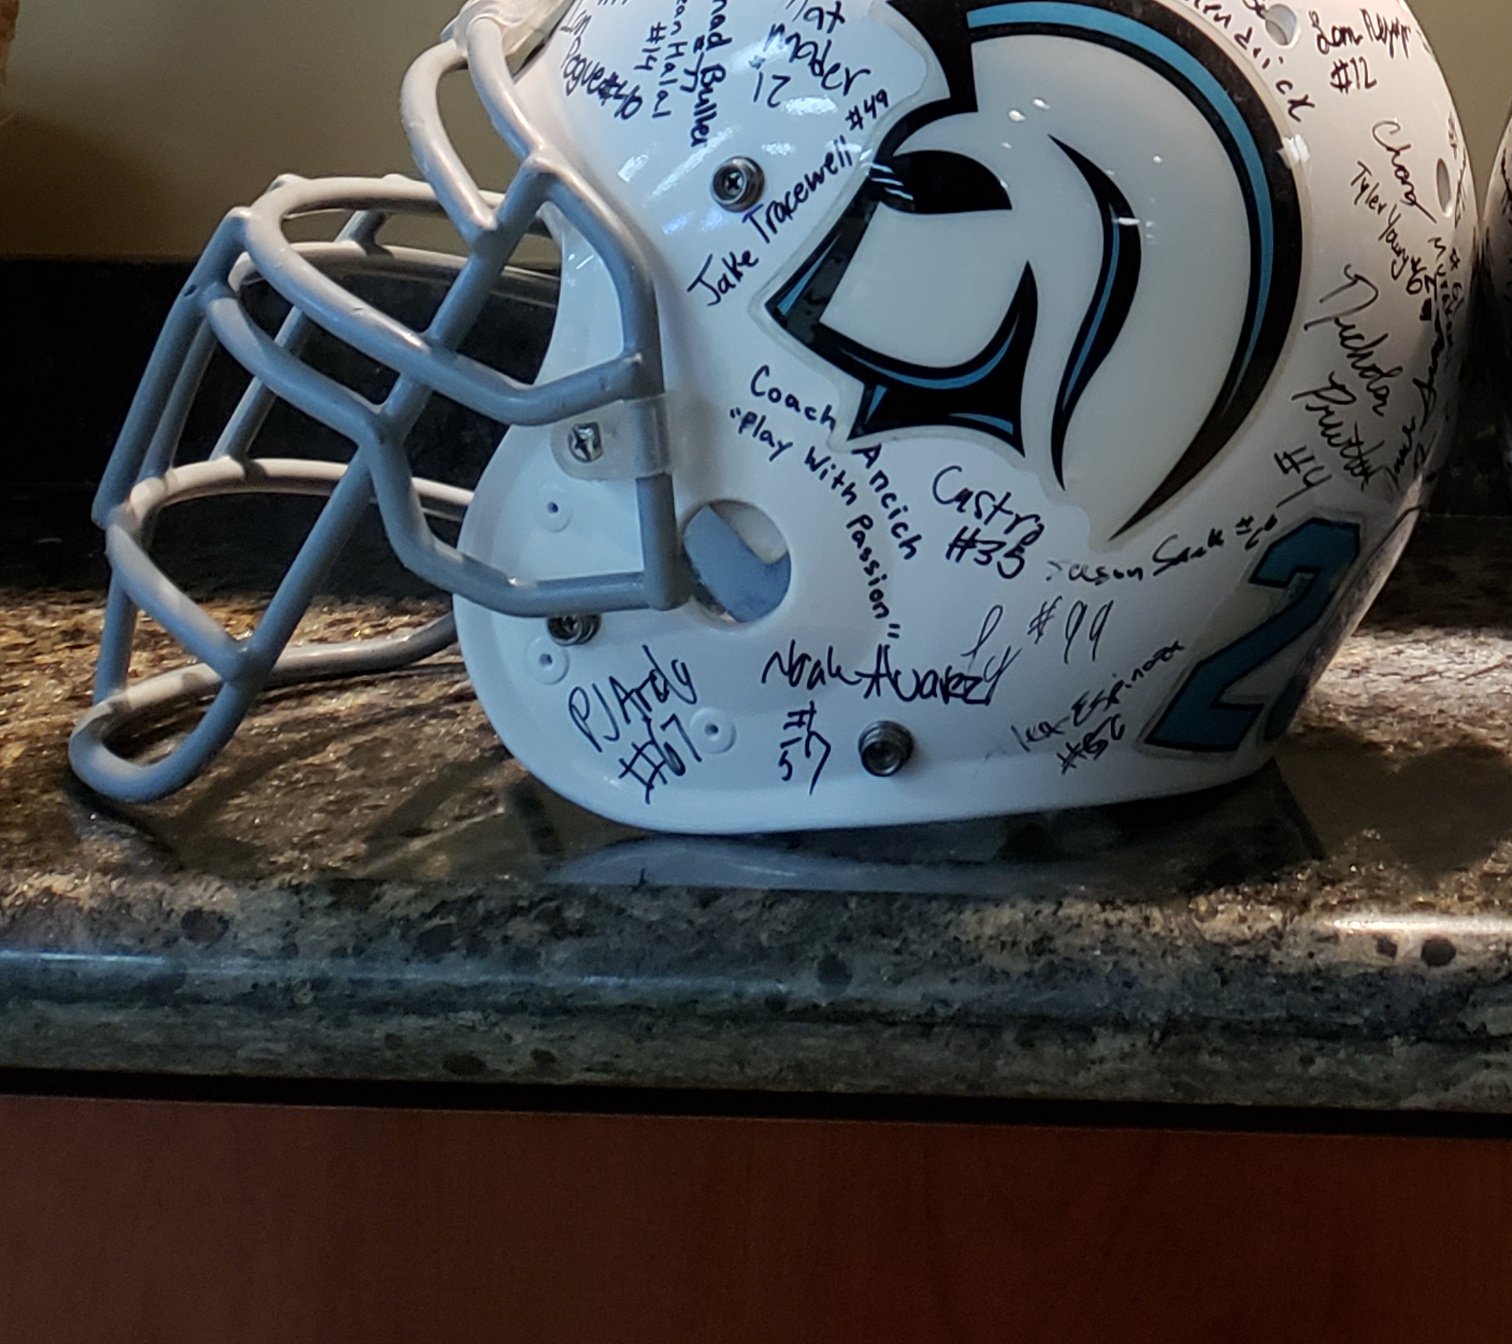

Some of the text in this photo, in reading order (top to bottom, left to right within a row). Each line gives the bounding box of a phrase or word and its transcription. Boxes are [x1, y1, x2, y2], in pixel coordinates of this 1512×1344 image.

[1329, 55, 1378, 95] #12
[687, 87, 889, 308] Jake Tracewell #49
[1350, 160, 1388, 216] Tyler
[749, 365, 838, 433] Coach
[803, 445, 859, 507] With
[945, 525, 1027, 581] #35
[1143, 515, 1366, 753] 2
